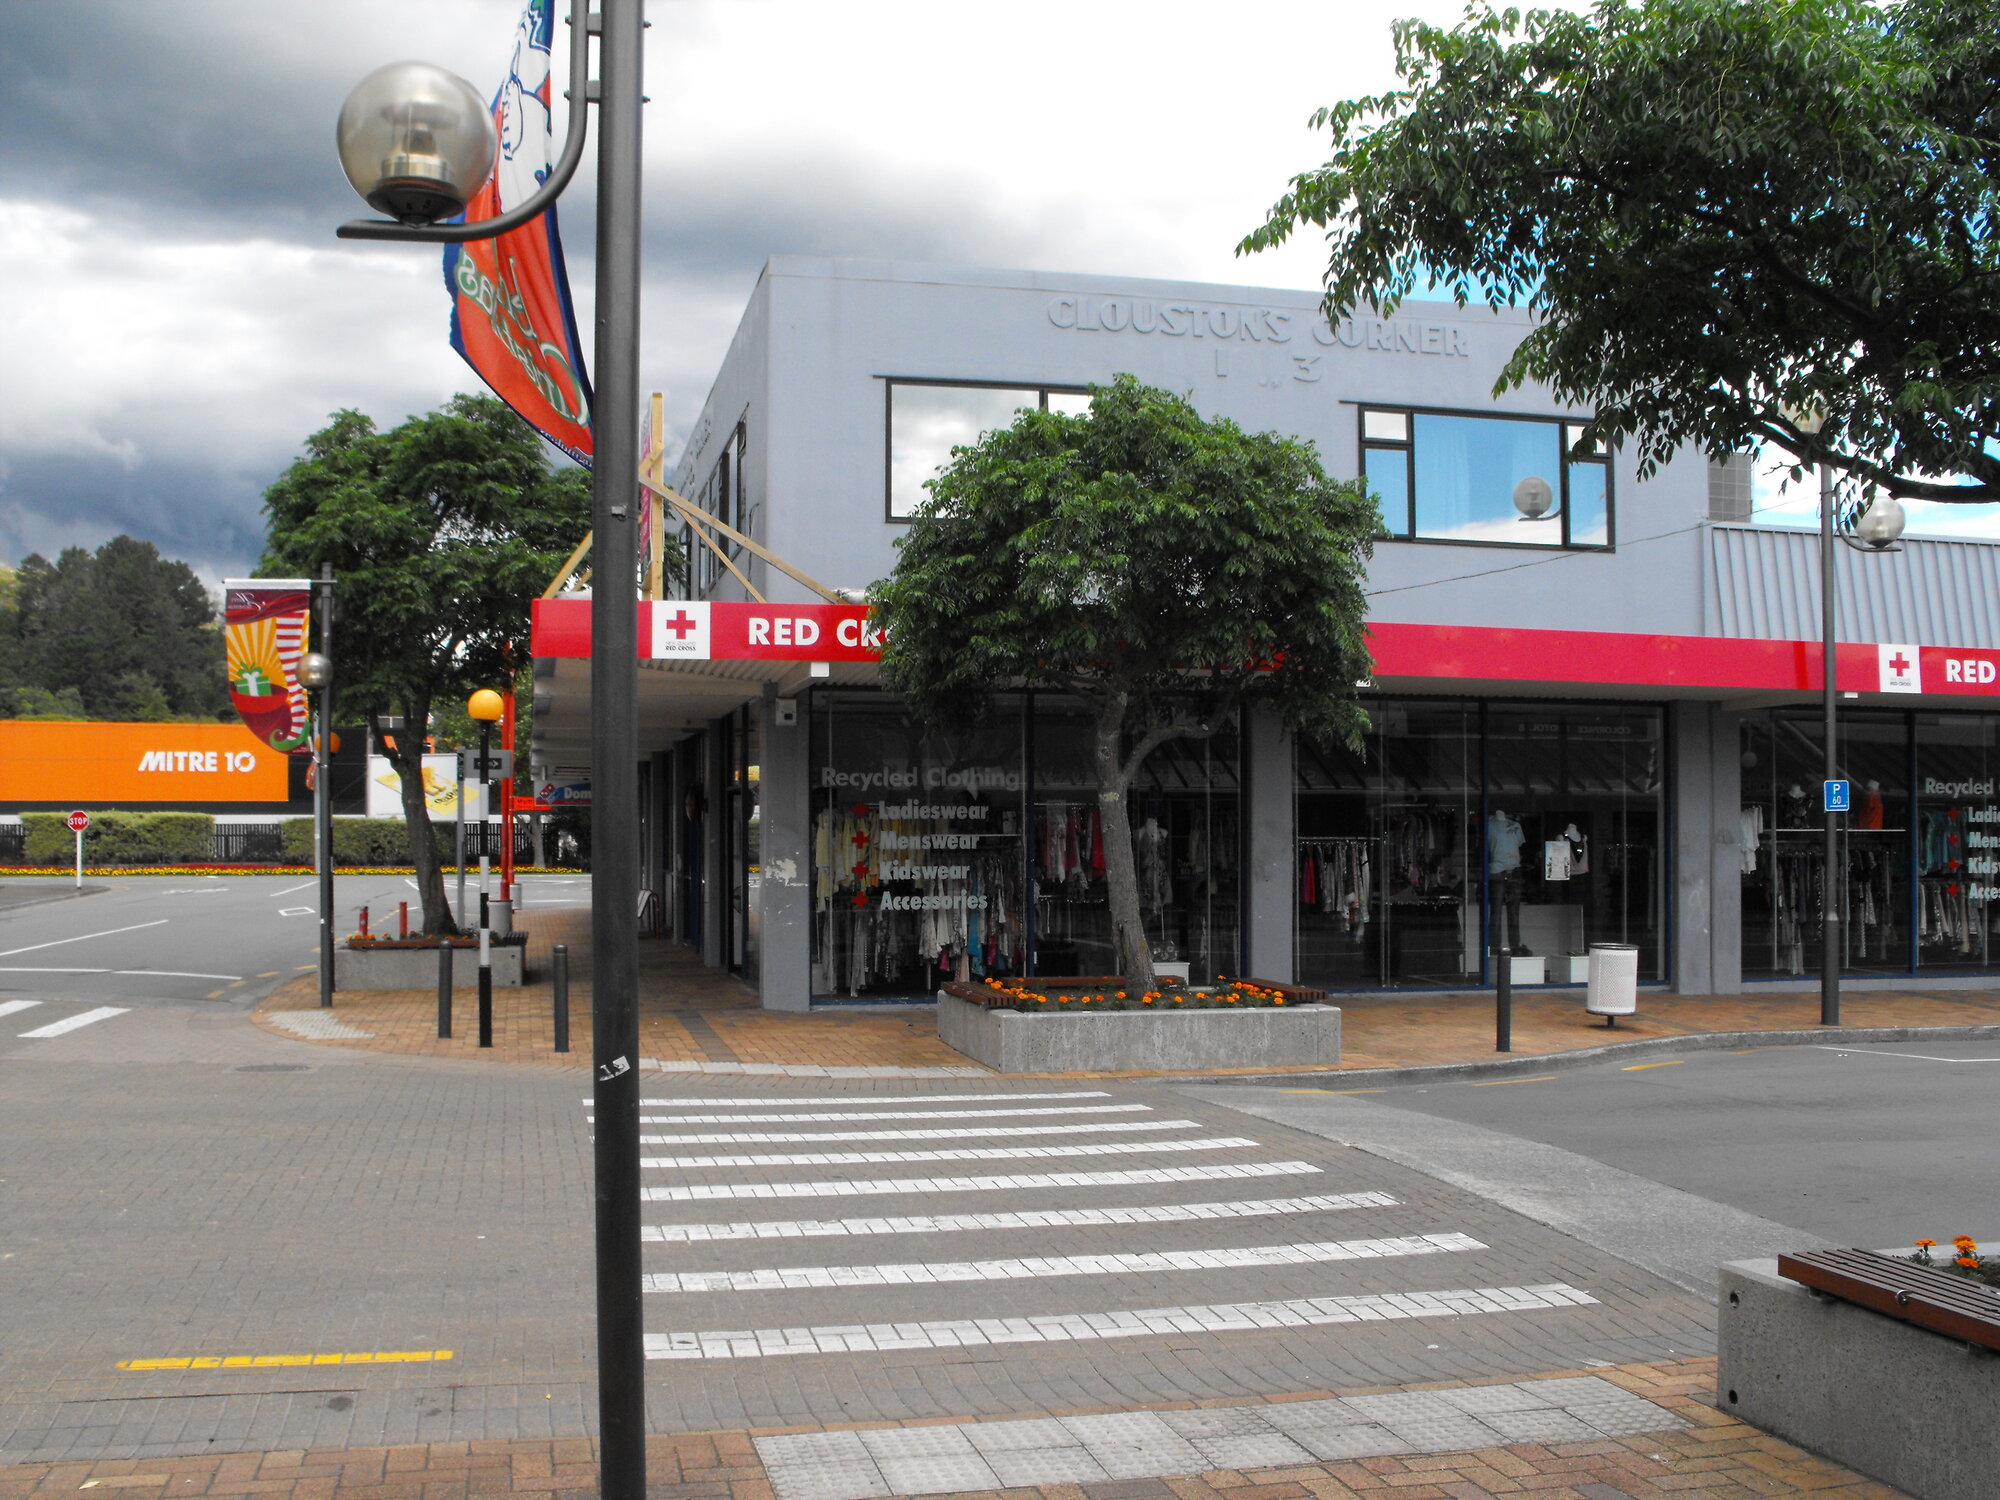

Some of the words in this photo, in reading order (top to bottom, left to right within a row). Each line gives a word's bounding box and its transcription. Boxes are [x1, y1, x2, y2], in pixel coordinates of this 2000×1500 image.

[1047, 297, 1292, 343] CLOUSTON'S
[1313, 317, 1469, 357] CORNER
[749, 617, 820, 645] RED
[836, 618, 897, 647] CR
[1946, 659, 1997, 684] RED
[137, 751, 218, 772] MITRE
[224, 751, 256, 773] 10
[821, 766, 918, 791] Recycled
[927, 767, 1020, 791] Clothing
[1925, 777, 1994, 799] Recycled
[1833, 784, 1841, 795] P
[879, 799, 989, 819] Ladieswear
[1832, 796, 1842, 805] 60
[70, 817, 88, 825] STOP
[879, 830, 980, 850] Menswear
[879, 859, 970, 880] Kidswear
[1968, 857, 2000, 874] Kids
[880, 889, 988, 911] Accessories
